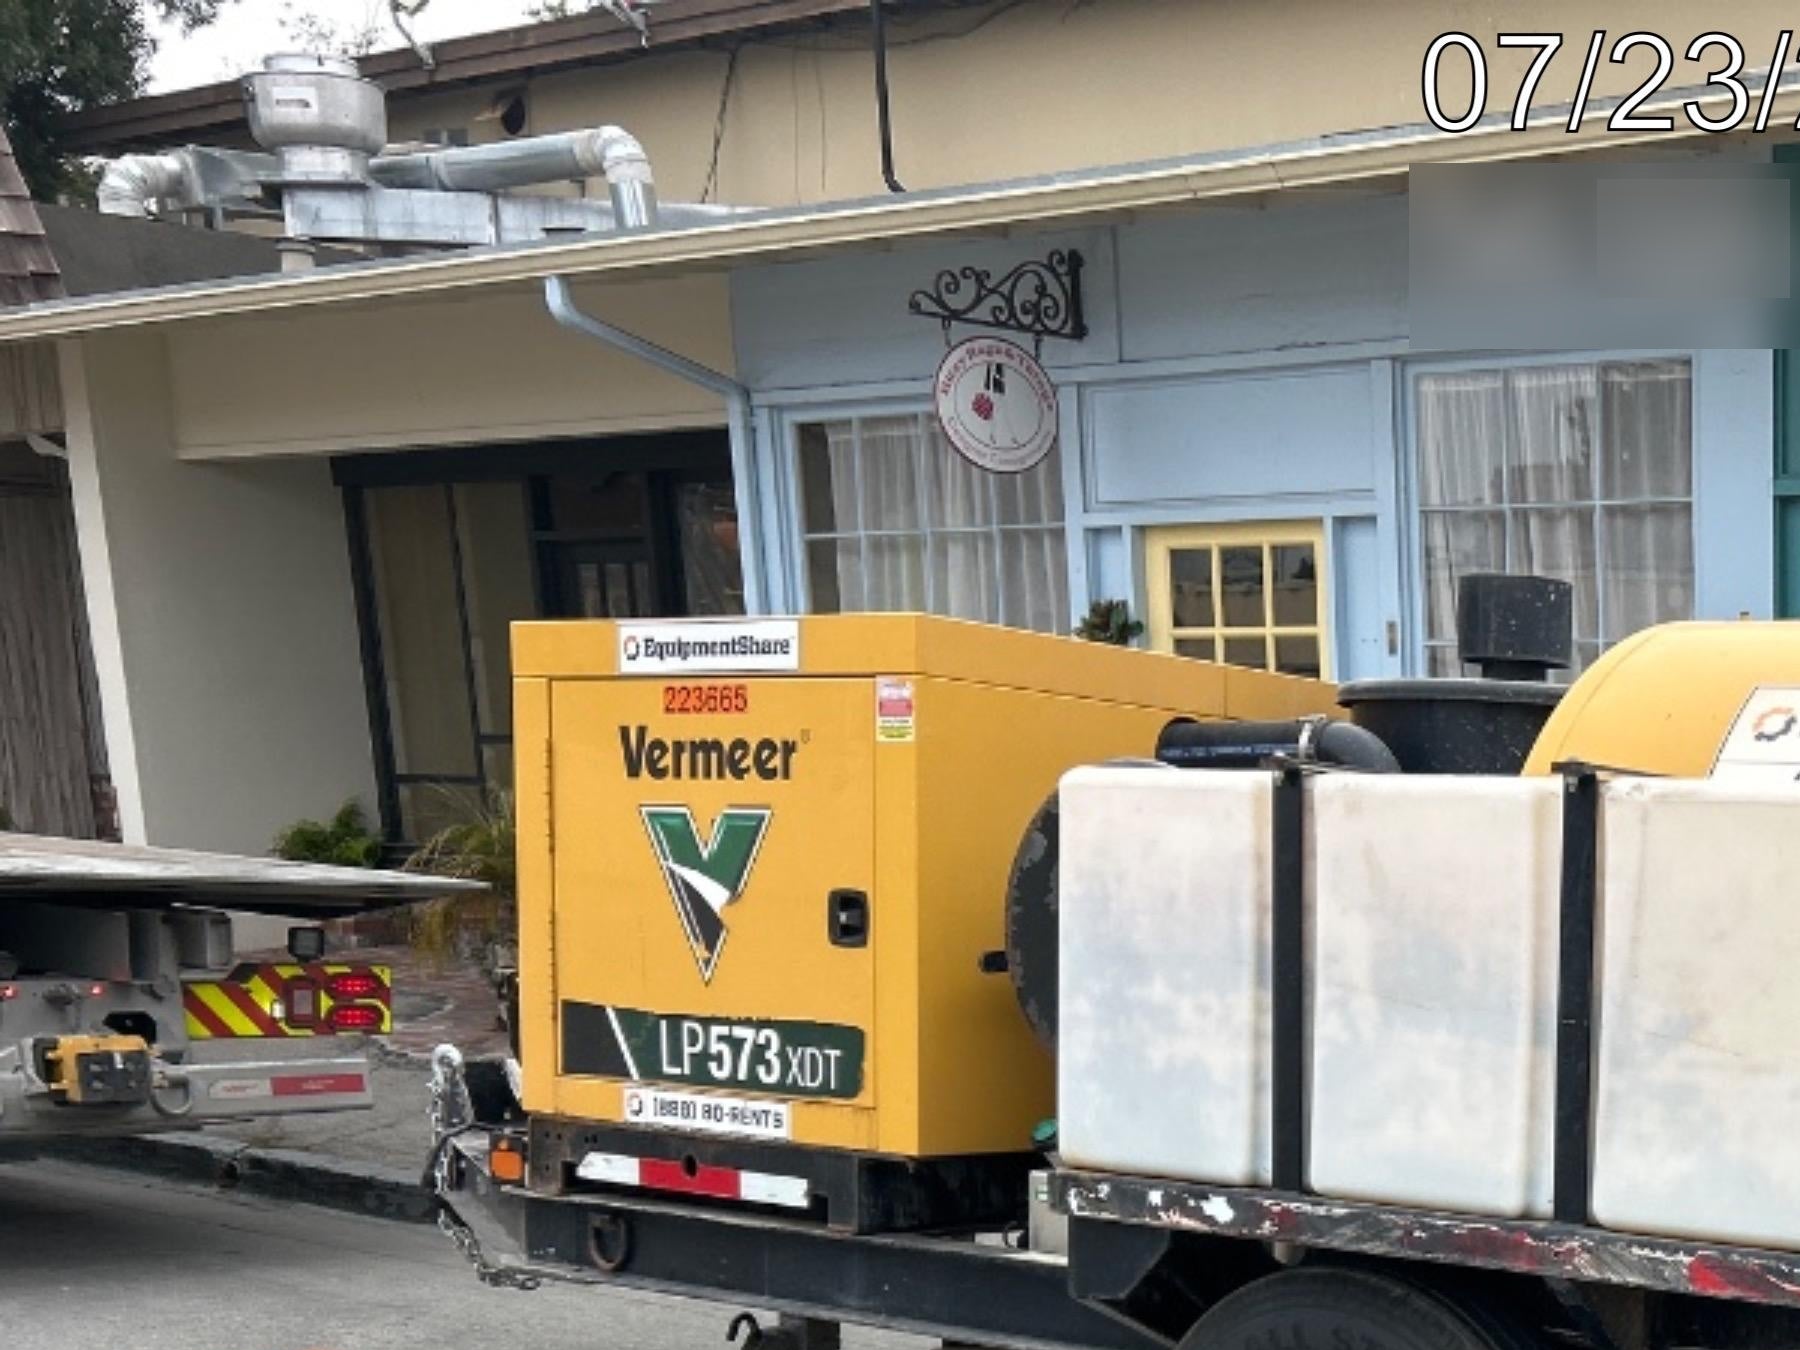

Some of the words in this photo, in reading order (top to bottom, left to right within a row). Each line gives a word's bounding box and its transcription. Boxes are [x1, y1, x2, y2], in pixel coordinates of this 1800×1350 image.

[643, 636, 790, 661] EquipmentShare
[664, 686, 747, 714] 223665
[619, 725, 798, 780] Vermeer
